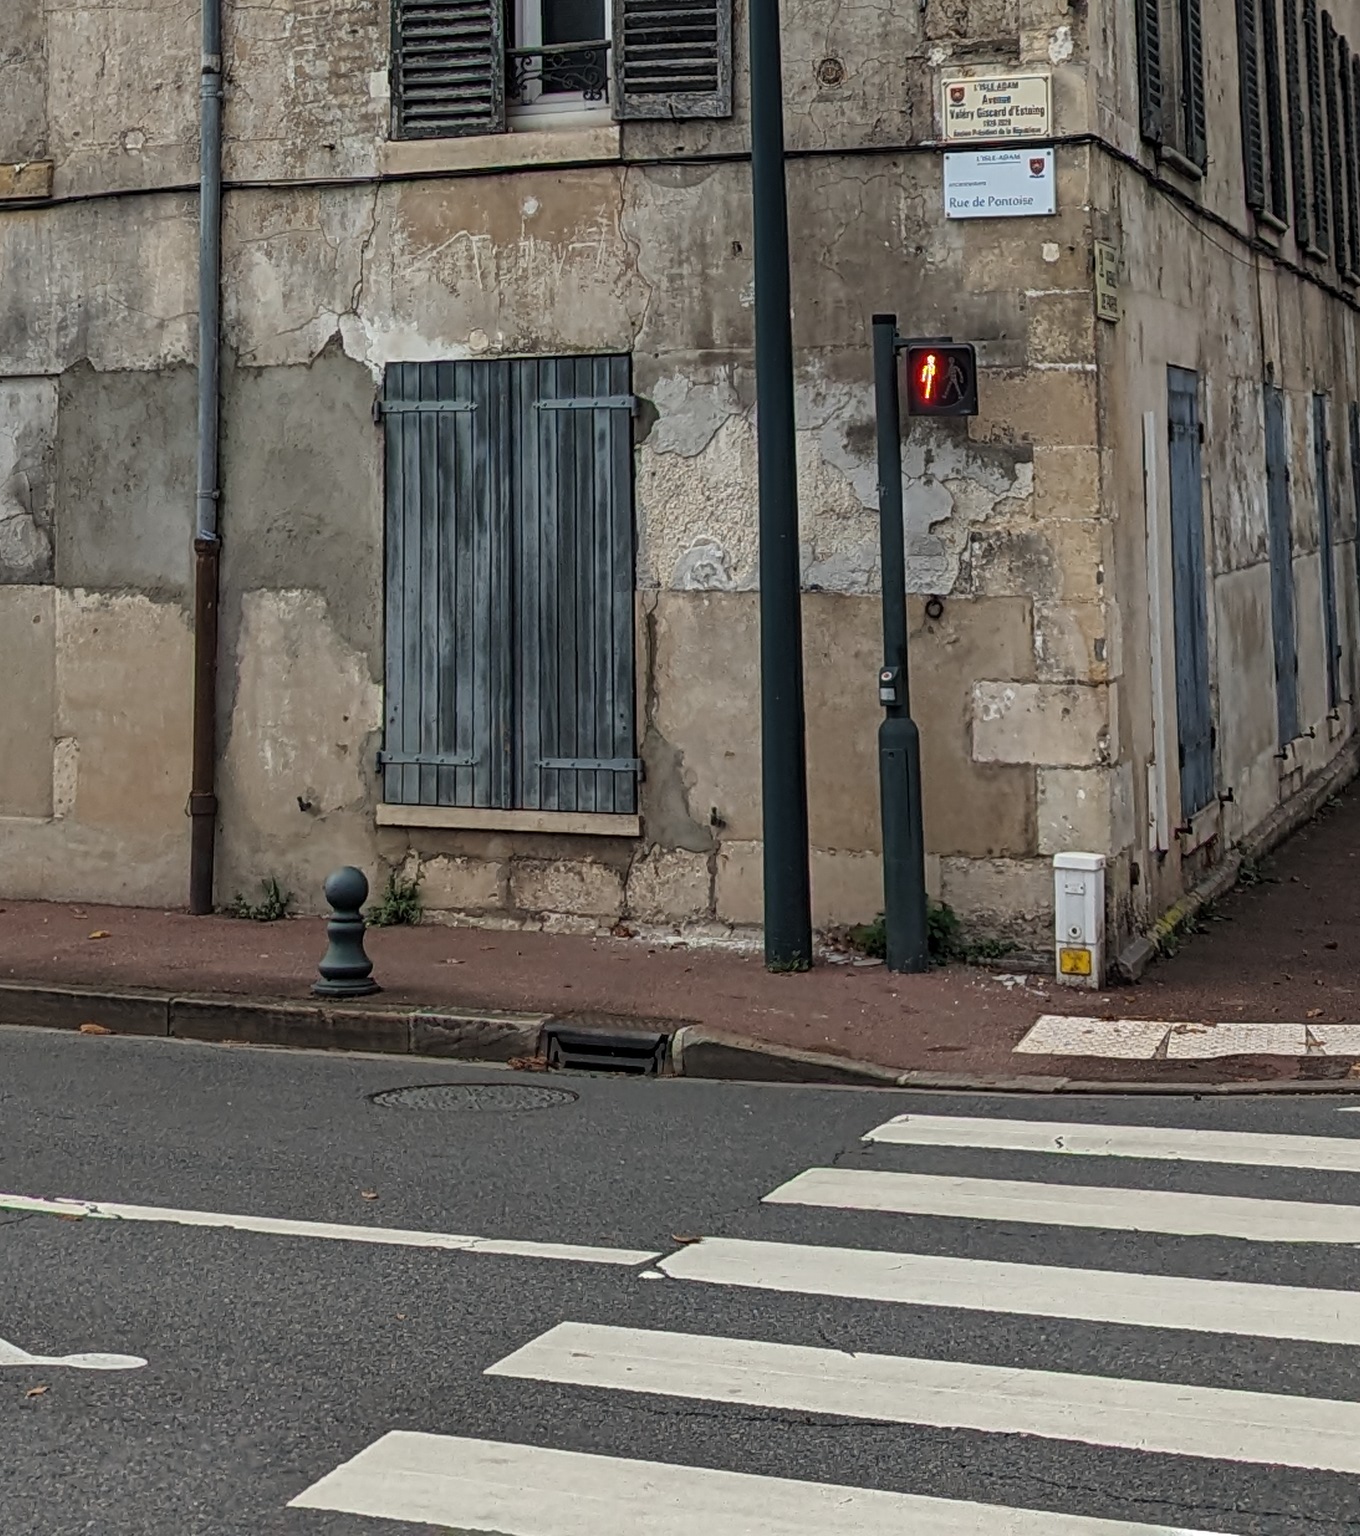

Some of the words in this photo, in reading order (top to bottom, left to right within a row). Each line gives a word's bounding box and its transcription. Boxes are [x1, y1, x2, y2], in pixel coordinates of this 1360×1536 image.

[981, 94, 1011, 104] Avenue
[949, 107, 975, 120] Valéry
[976, 106, 1007, 118] Giscard
[1008, 104, 1045, 117] d'Estaing
[949, 197, 970, 208] Rue
[972, 196, 986, 207] de
[987, 195, 1034, 206] Pontoise
